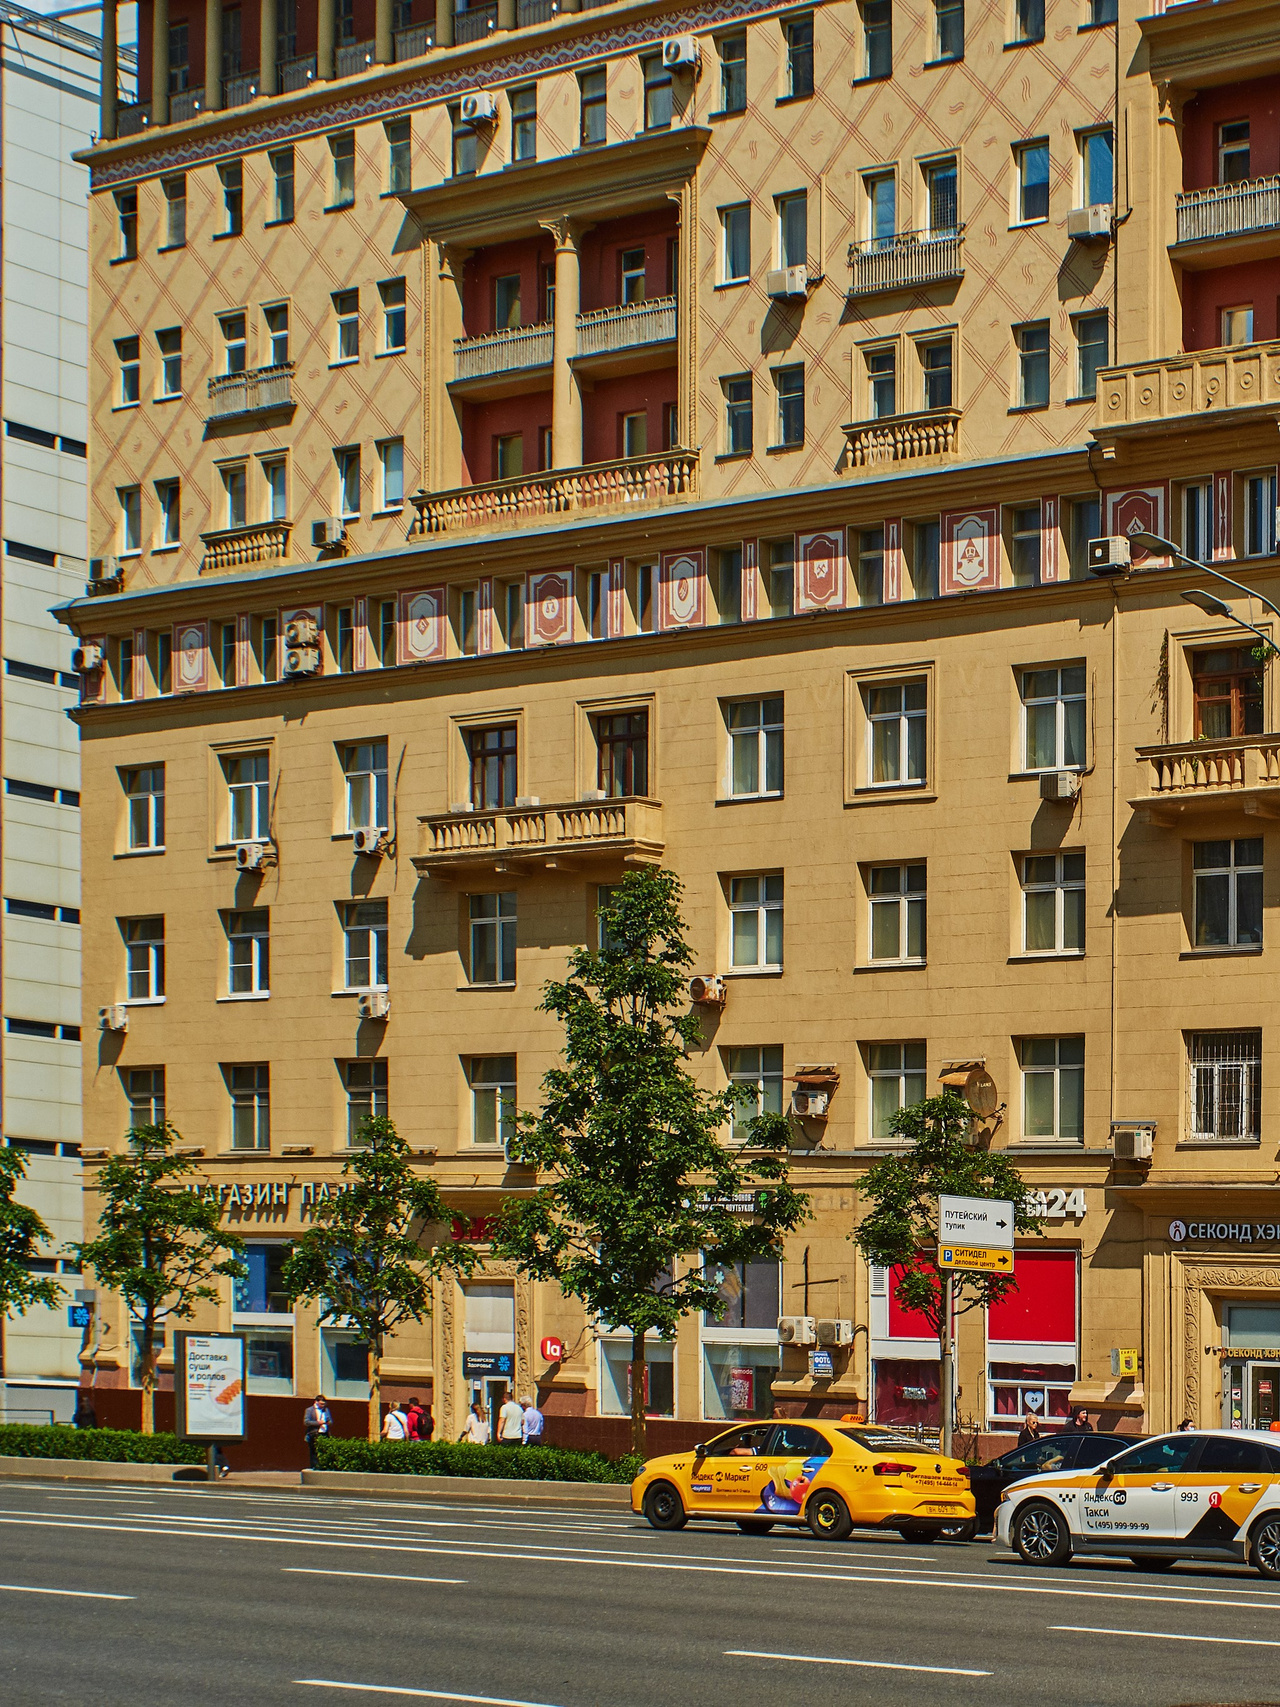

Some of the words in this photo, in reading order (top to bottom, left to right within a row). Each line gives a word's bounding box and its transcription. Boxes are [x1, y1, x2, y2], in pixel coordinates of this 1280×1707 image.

[1047, 1188, 1087, 1218] 24
[945, 1210, 988, 1222] ПУТЕЙСКИЙ
[945, 1222, 966, 1230] тупик
[1189, 1223, 1252, 1243] СЕКОНД
[955, 1249, 987, 1259] СИТИДЕЛ
[955, 1259, 978, 1267] деловой
[546, 1340, 560, 1356] la
[189, 1352, 228, 1362] Доставка
[1228, 1349, 1263, 1359] СЕКОНД
[189, 1363, 211, 1371] суши
[754, 1463, 768, 1472] 609
[691, 1472, 714, 1481] Яндекс
[724, 1472, 750, 1482] Маркет
[906, 1472, 941, 1480] Приглашаем
[1084, 1492, 1114, 1504] Яндекс
[1180, 1492, 1199, 1502] 993
[1211, 1494, 1218, 1505] Я
[1084, 1507, 1110, 1517] Такси
[1094, 1520, 1113, 1530] (495)
[1114, 1521, 1150, 1530] 999-99-99
